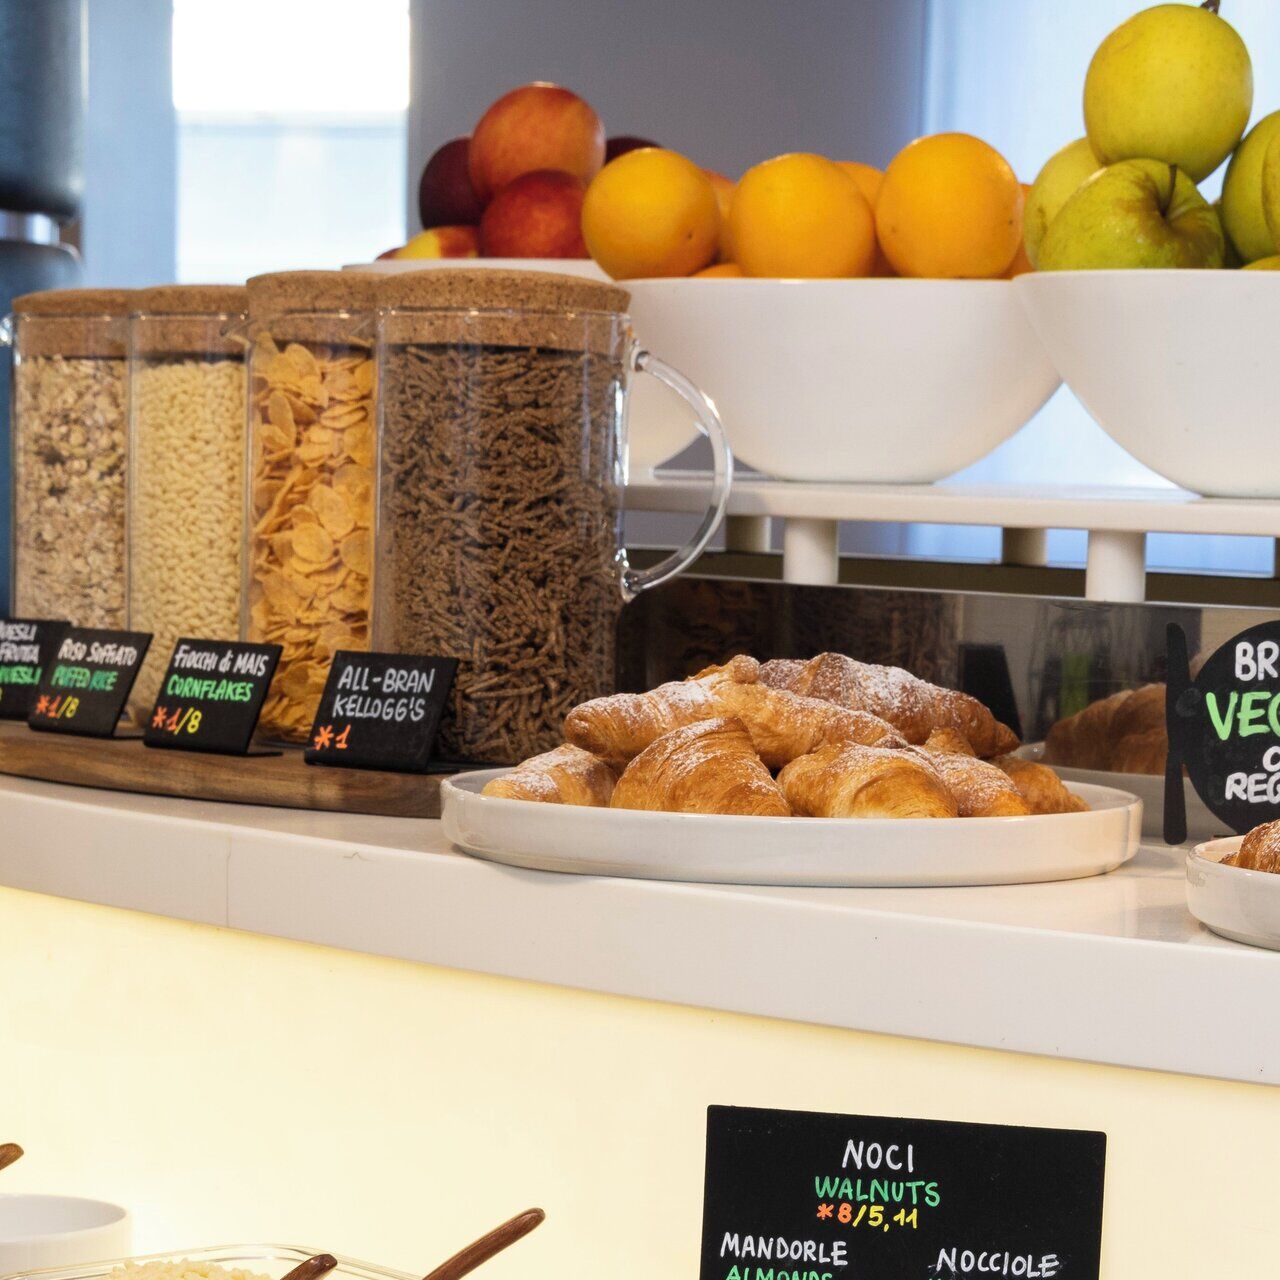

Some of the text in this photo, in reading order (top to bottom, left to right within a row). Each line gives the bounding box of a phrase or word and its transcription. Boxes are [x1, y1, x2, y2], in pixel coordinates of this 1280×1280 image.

[232, 652, 269, 677] MAIS
[337, 665, 436, 694] ALL-BRAN
[167, 673, 254, 702] CORNFLAKES
[331, 694, 426, 722] KELLOGG'S
[842, 1139, 914, 1173] NOCI
[815, 1176, 941, 1207] WALNUTS
[720, 1232, 848, 1266] MANDORLE
[936, 1247, 1059, 1278] NOCCIOLE
